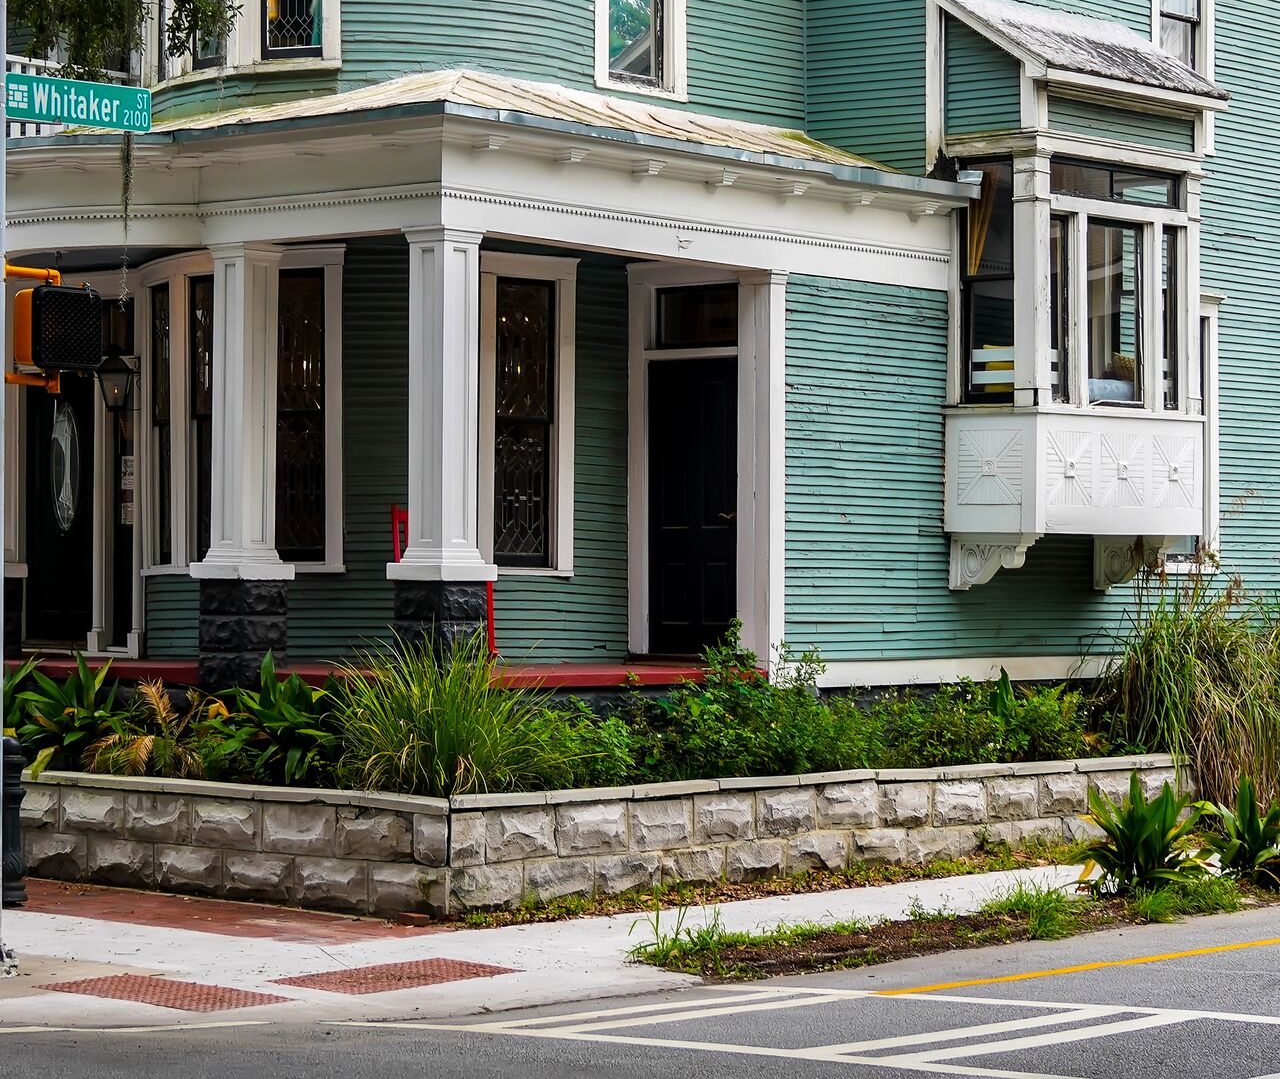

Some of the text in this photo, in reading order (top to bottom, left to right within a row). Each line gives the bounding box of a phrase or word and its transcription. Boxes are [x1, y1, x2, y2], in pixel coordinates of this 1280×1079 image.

[32, 82, 120, 123] Whitaker
[136, 93, 149, 110] ST
[123, 110, 149, 128] 2100
